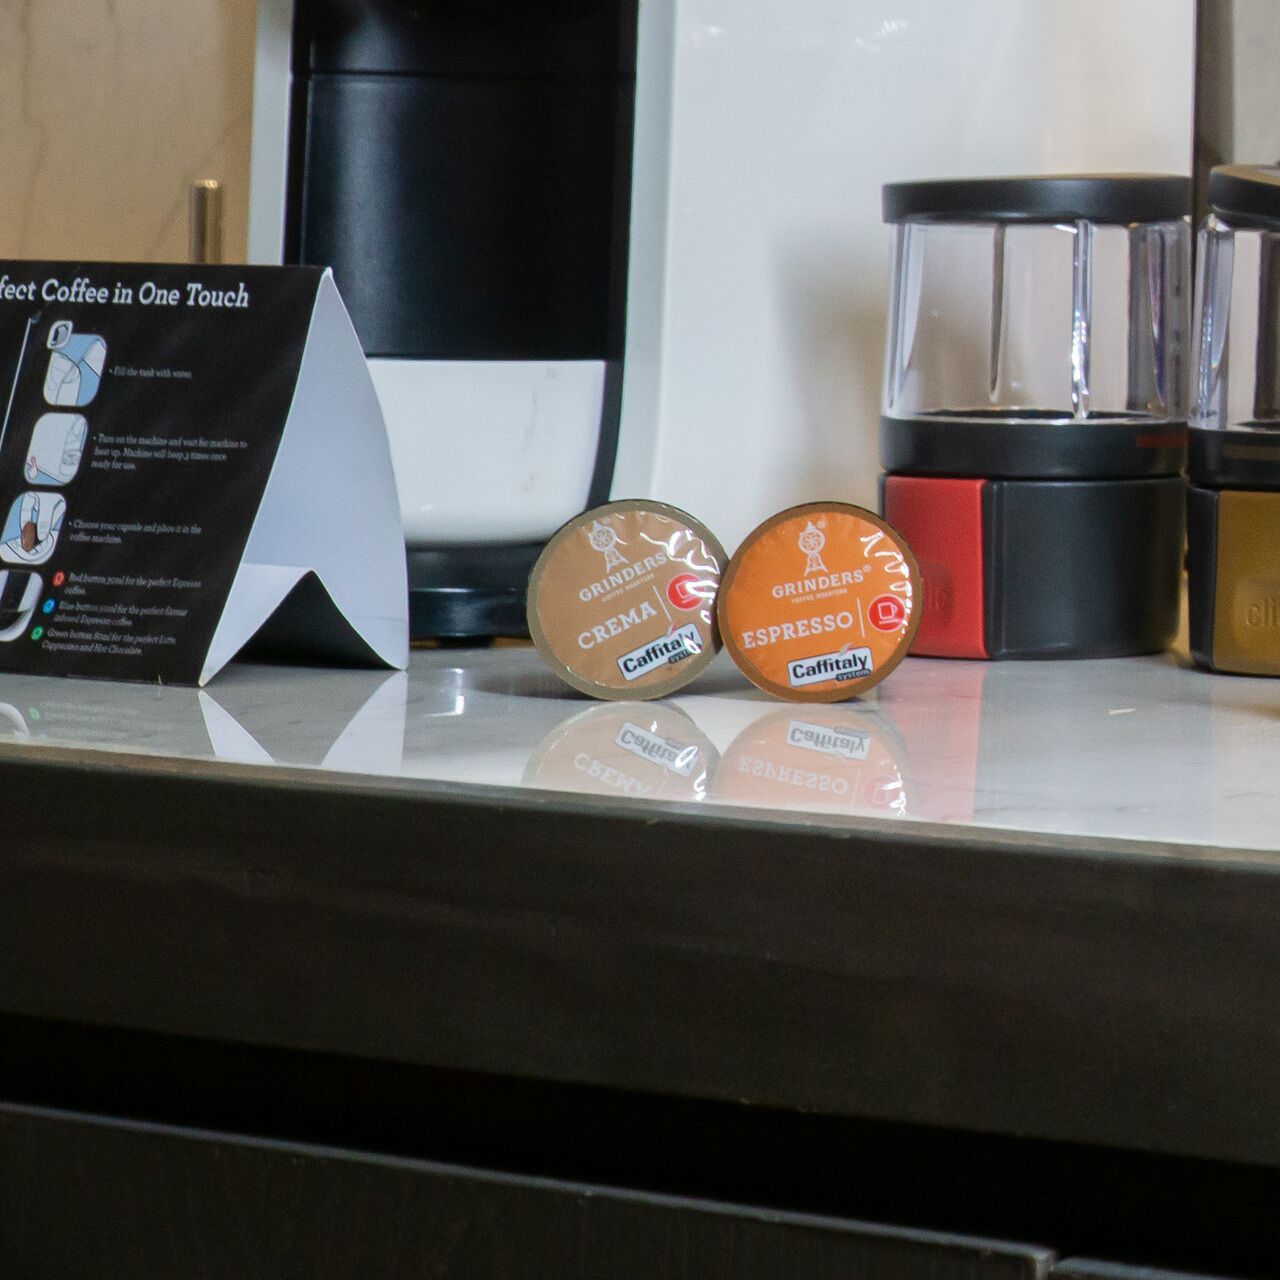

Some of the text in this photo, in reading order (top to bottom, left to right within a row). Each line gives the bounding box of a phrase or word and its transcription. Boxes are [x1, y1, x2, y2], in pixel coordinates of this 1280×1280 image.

[41, 277, 109, 304] Coffee
[112, 282, 133, 304] in
[139, 281, 180, 305] One
[186, 282, 249, 308] Touch
[578, 552, 668, 602] GRINDERS
[772, 570, 864, 599] GRINDERS
[578, 601, 658, 650] CREMA
[742, 611, 853, 649] ESPRESSO
[792, 653, 868, 679] Caffitaly
[837, 669, 870, 682] system
